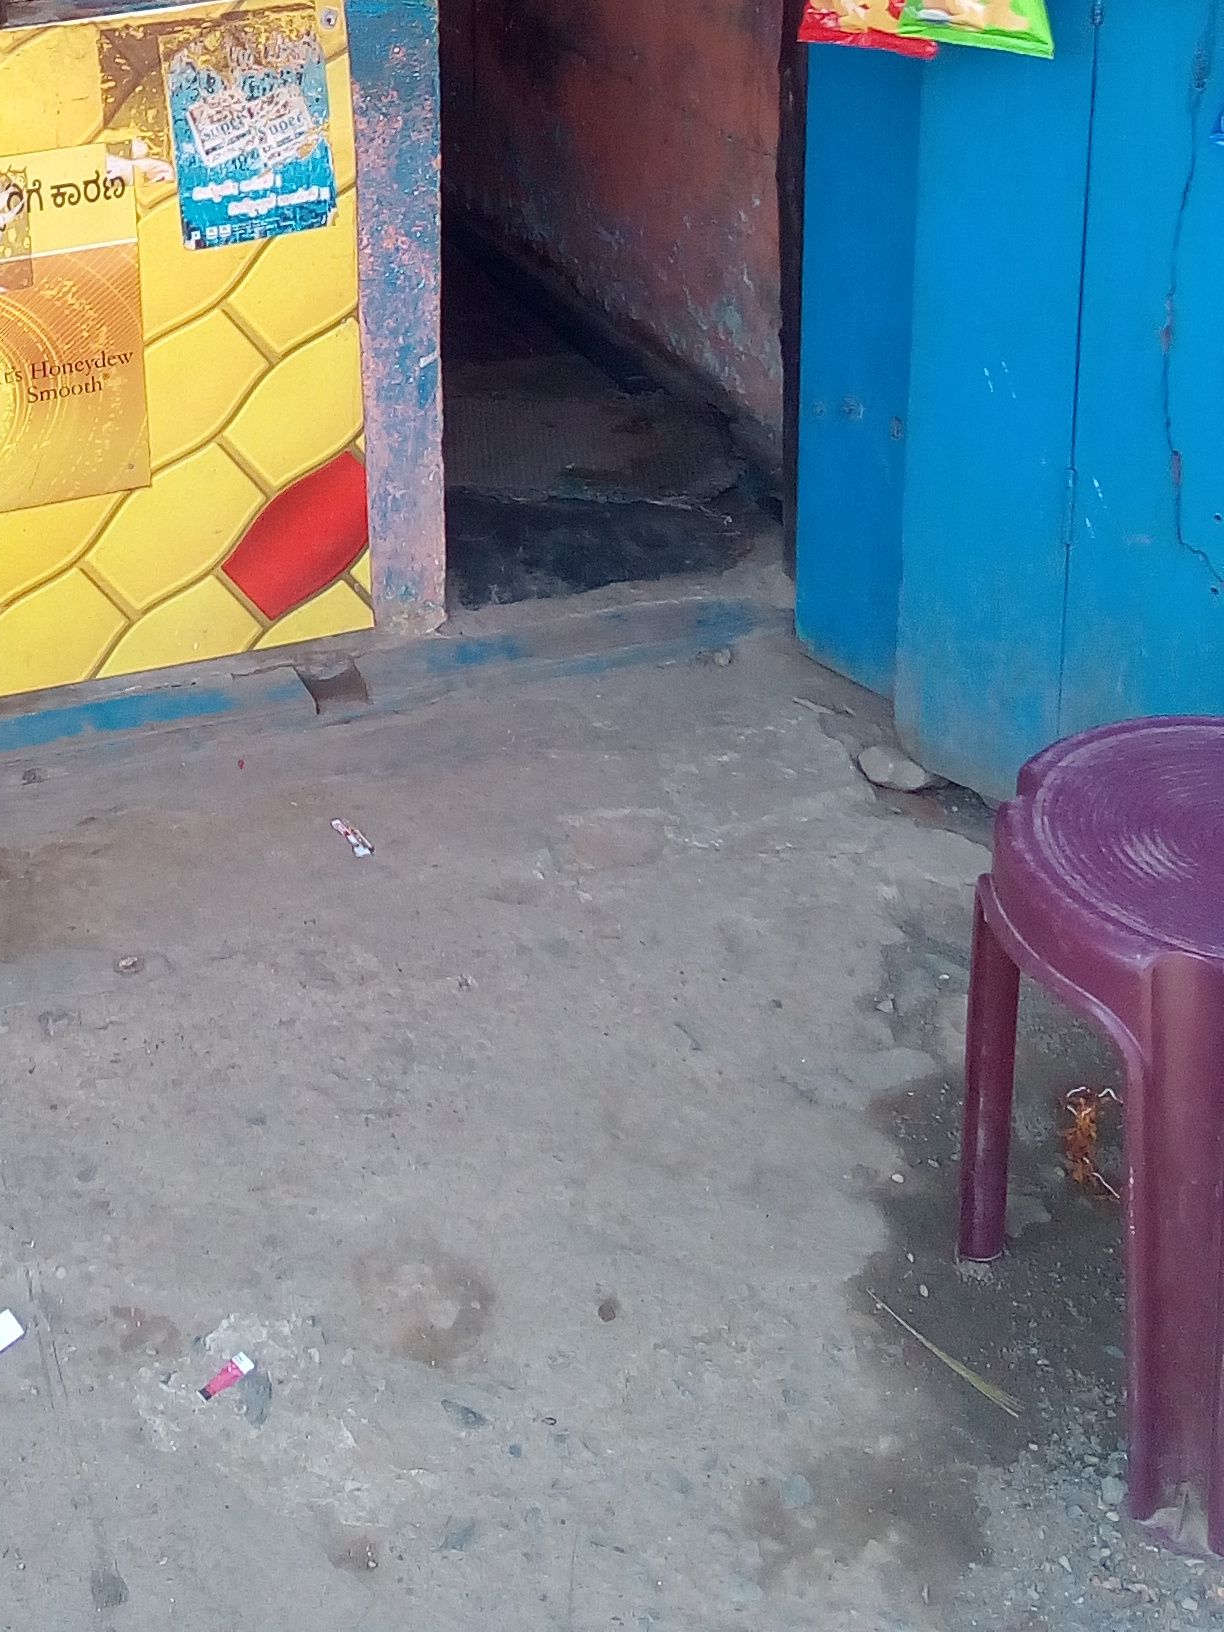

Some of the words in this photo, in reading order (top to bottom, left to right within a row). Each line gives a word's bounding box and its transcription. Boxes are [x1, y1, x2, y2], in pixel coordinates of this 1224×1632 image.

[51, 170, 126, 208] ಕಾರಣ
[31, 351, 133, 379] Honeydew
[28, 376, 102, 403] Smooth
